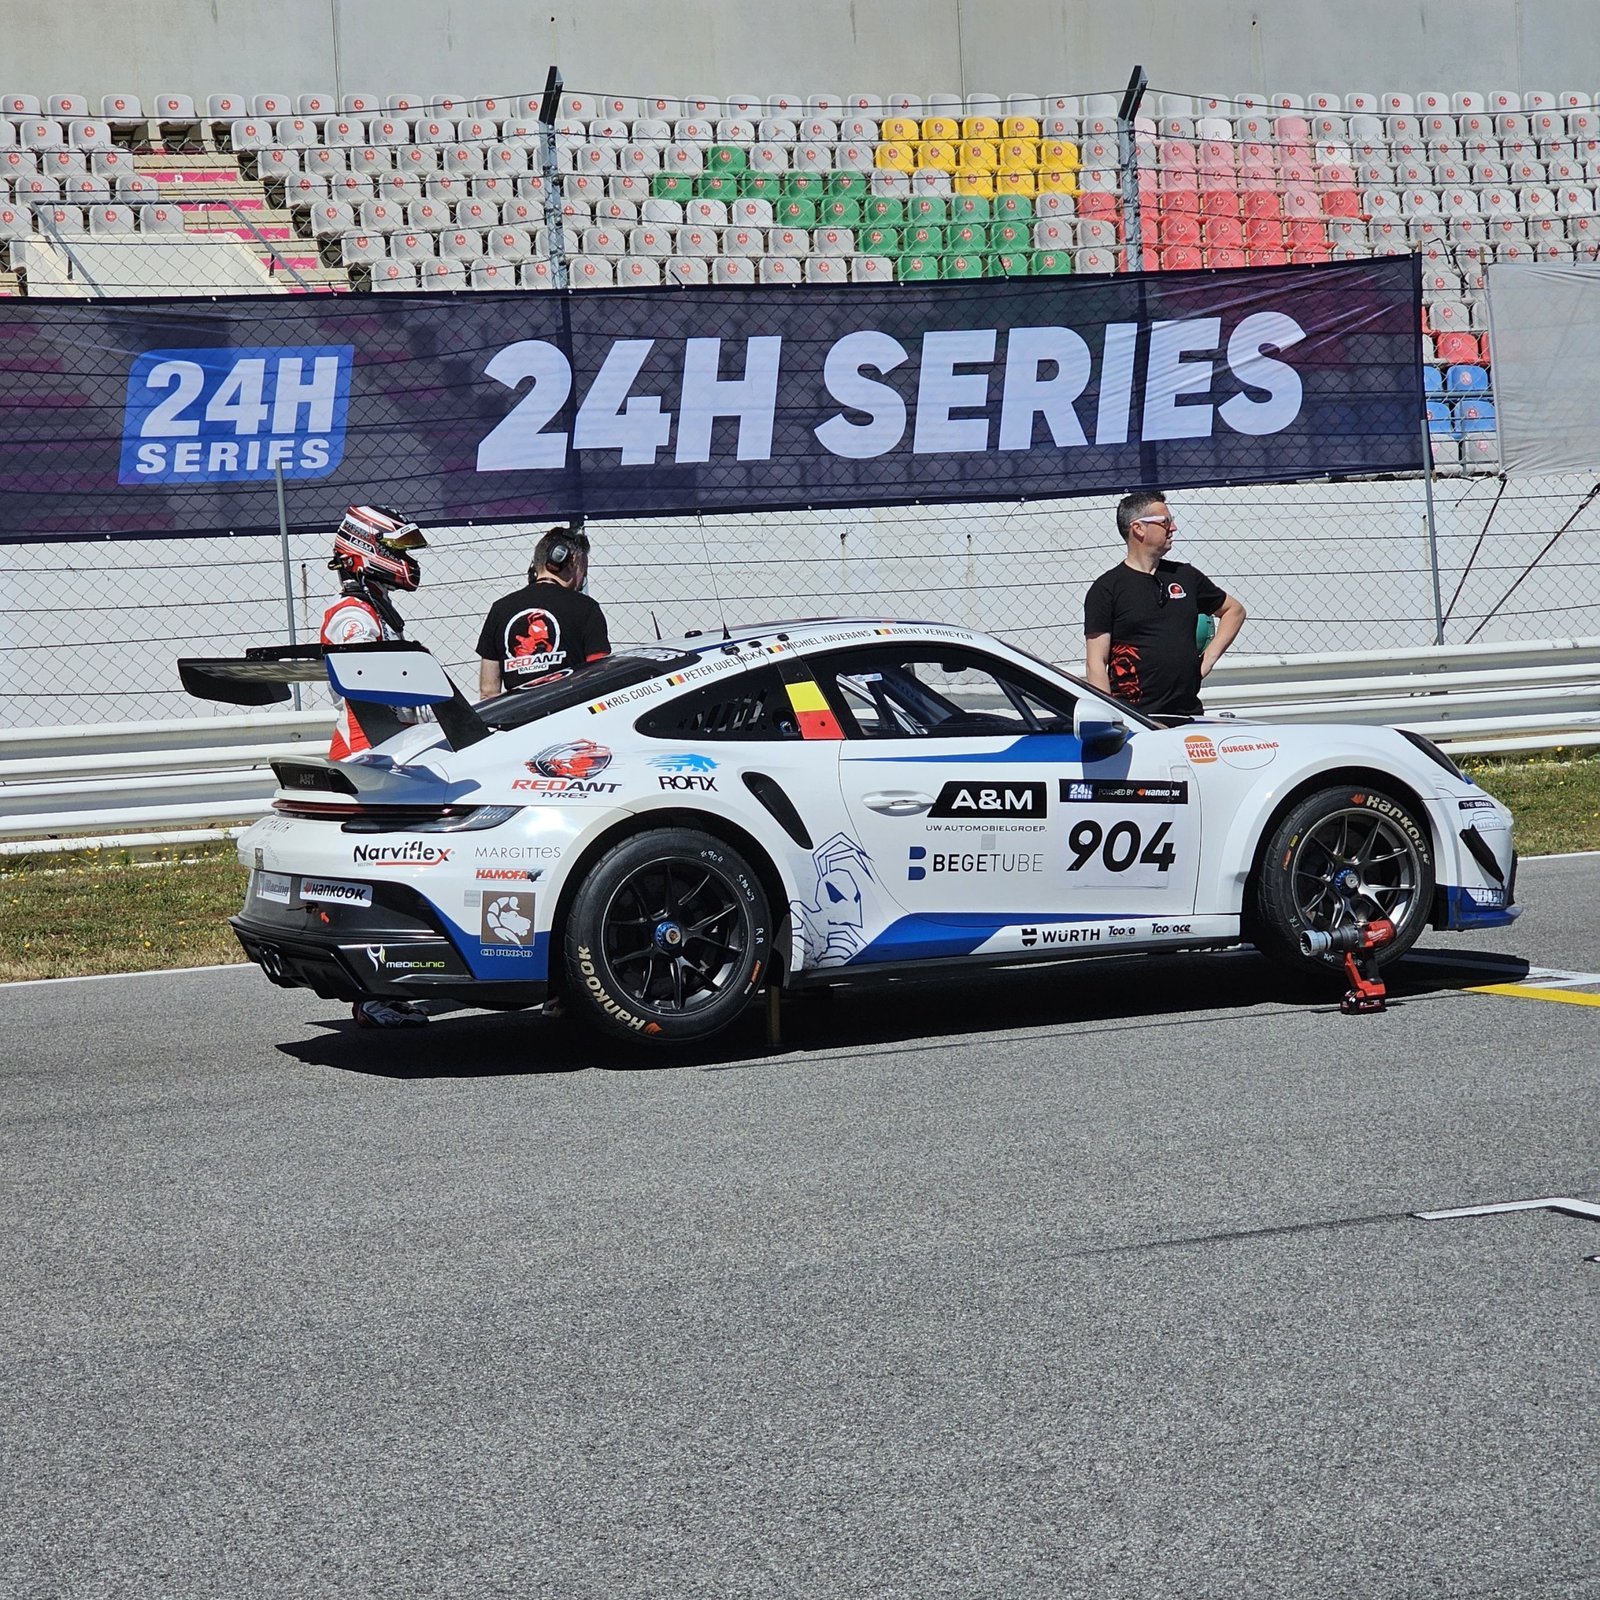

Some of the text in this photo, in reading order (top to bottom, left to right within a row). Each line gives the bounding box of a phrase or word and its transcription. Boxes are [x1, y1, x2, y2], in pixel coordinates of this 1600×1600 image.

[140, 355, 339, 438] 24H
[476, 310, 1307, 472] 24H SERIES
[135, 438, 331, 475] SERIES
[605, 694, 630, 709] KRIS
[631, 682, 663, 701] COOLS
[683, 664, 715, 681] PETER
[782, 638, 821, 651] MICHIEL
[823, 629, 872, 643] HAVERANS
[892, 627, 923, 635] BRENT
[924, 628, 974, 641] VERHEYEN
[1185, 742, 1214, 750] BURGER
[1187, 748, 1217, 758] KING
[1221, 741, 1280, 754] BURGER KING
[658, 775, 720, 792] ROFIX
[951, 788, 1033, 811] A&M
[925, 824, 1048, 833] UW AUTOMOBIELGROEP.
[353, 840, 452, 863] Narviflex
[1066, 820, 1177, 872] 904
[932, 853, 1045, 872] BEGETUBE
[475, 869, 529, 880] HAMOFA
[755, 927, 764, 945] RR
